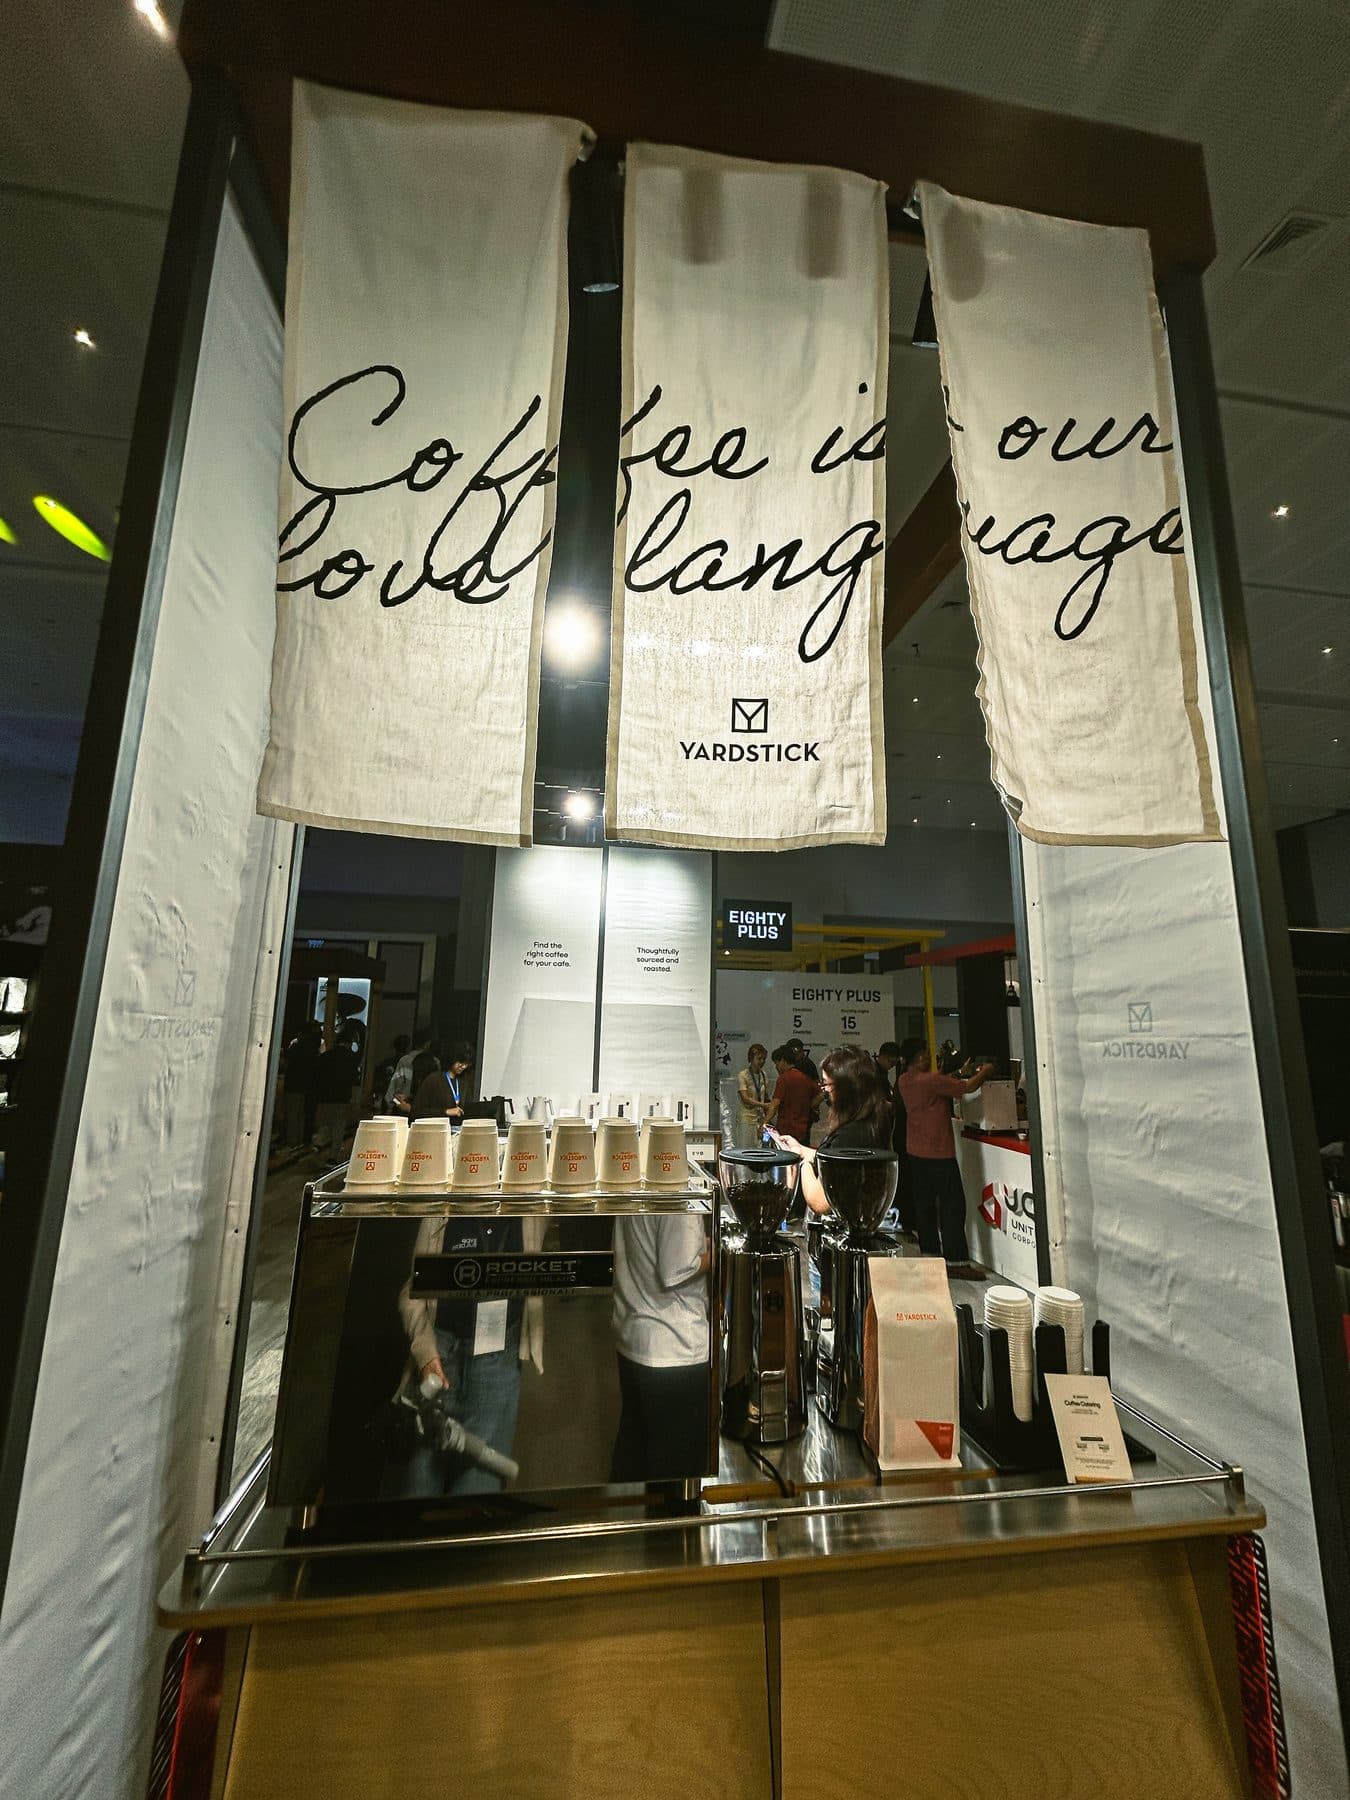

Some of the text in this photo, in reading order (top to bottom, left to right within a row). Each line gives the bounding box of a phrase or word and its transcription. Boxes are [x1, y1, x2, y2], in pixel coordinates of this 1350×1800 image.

[811, 382, 887, 473] is
[998, 412, 1174, 461] our
[679, 741, 820, 763] YARDSTICK
[729, 910, 787, 926] EIGHTY
[737, 924, 779, 940] PLUS
[533, 941, 549, 949] Find
[636, 946, 680, 957] Thoughtfully
[526, 951, 569, 959] right coffee
[792, 987, 881, 1003] EIGHTY PLUS
[793, 1015, 803, 1028] 5
[841, 1016, 857, 1030] 15
[1011, 1218, 1034, 1236] UNIT
[486, 1259, 577, 1273] ROCKET
